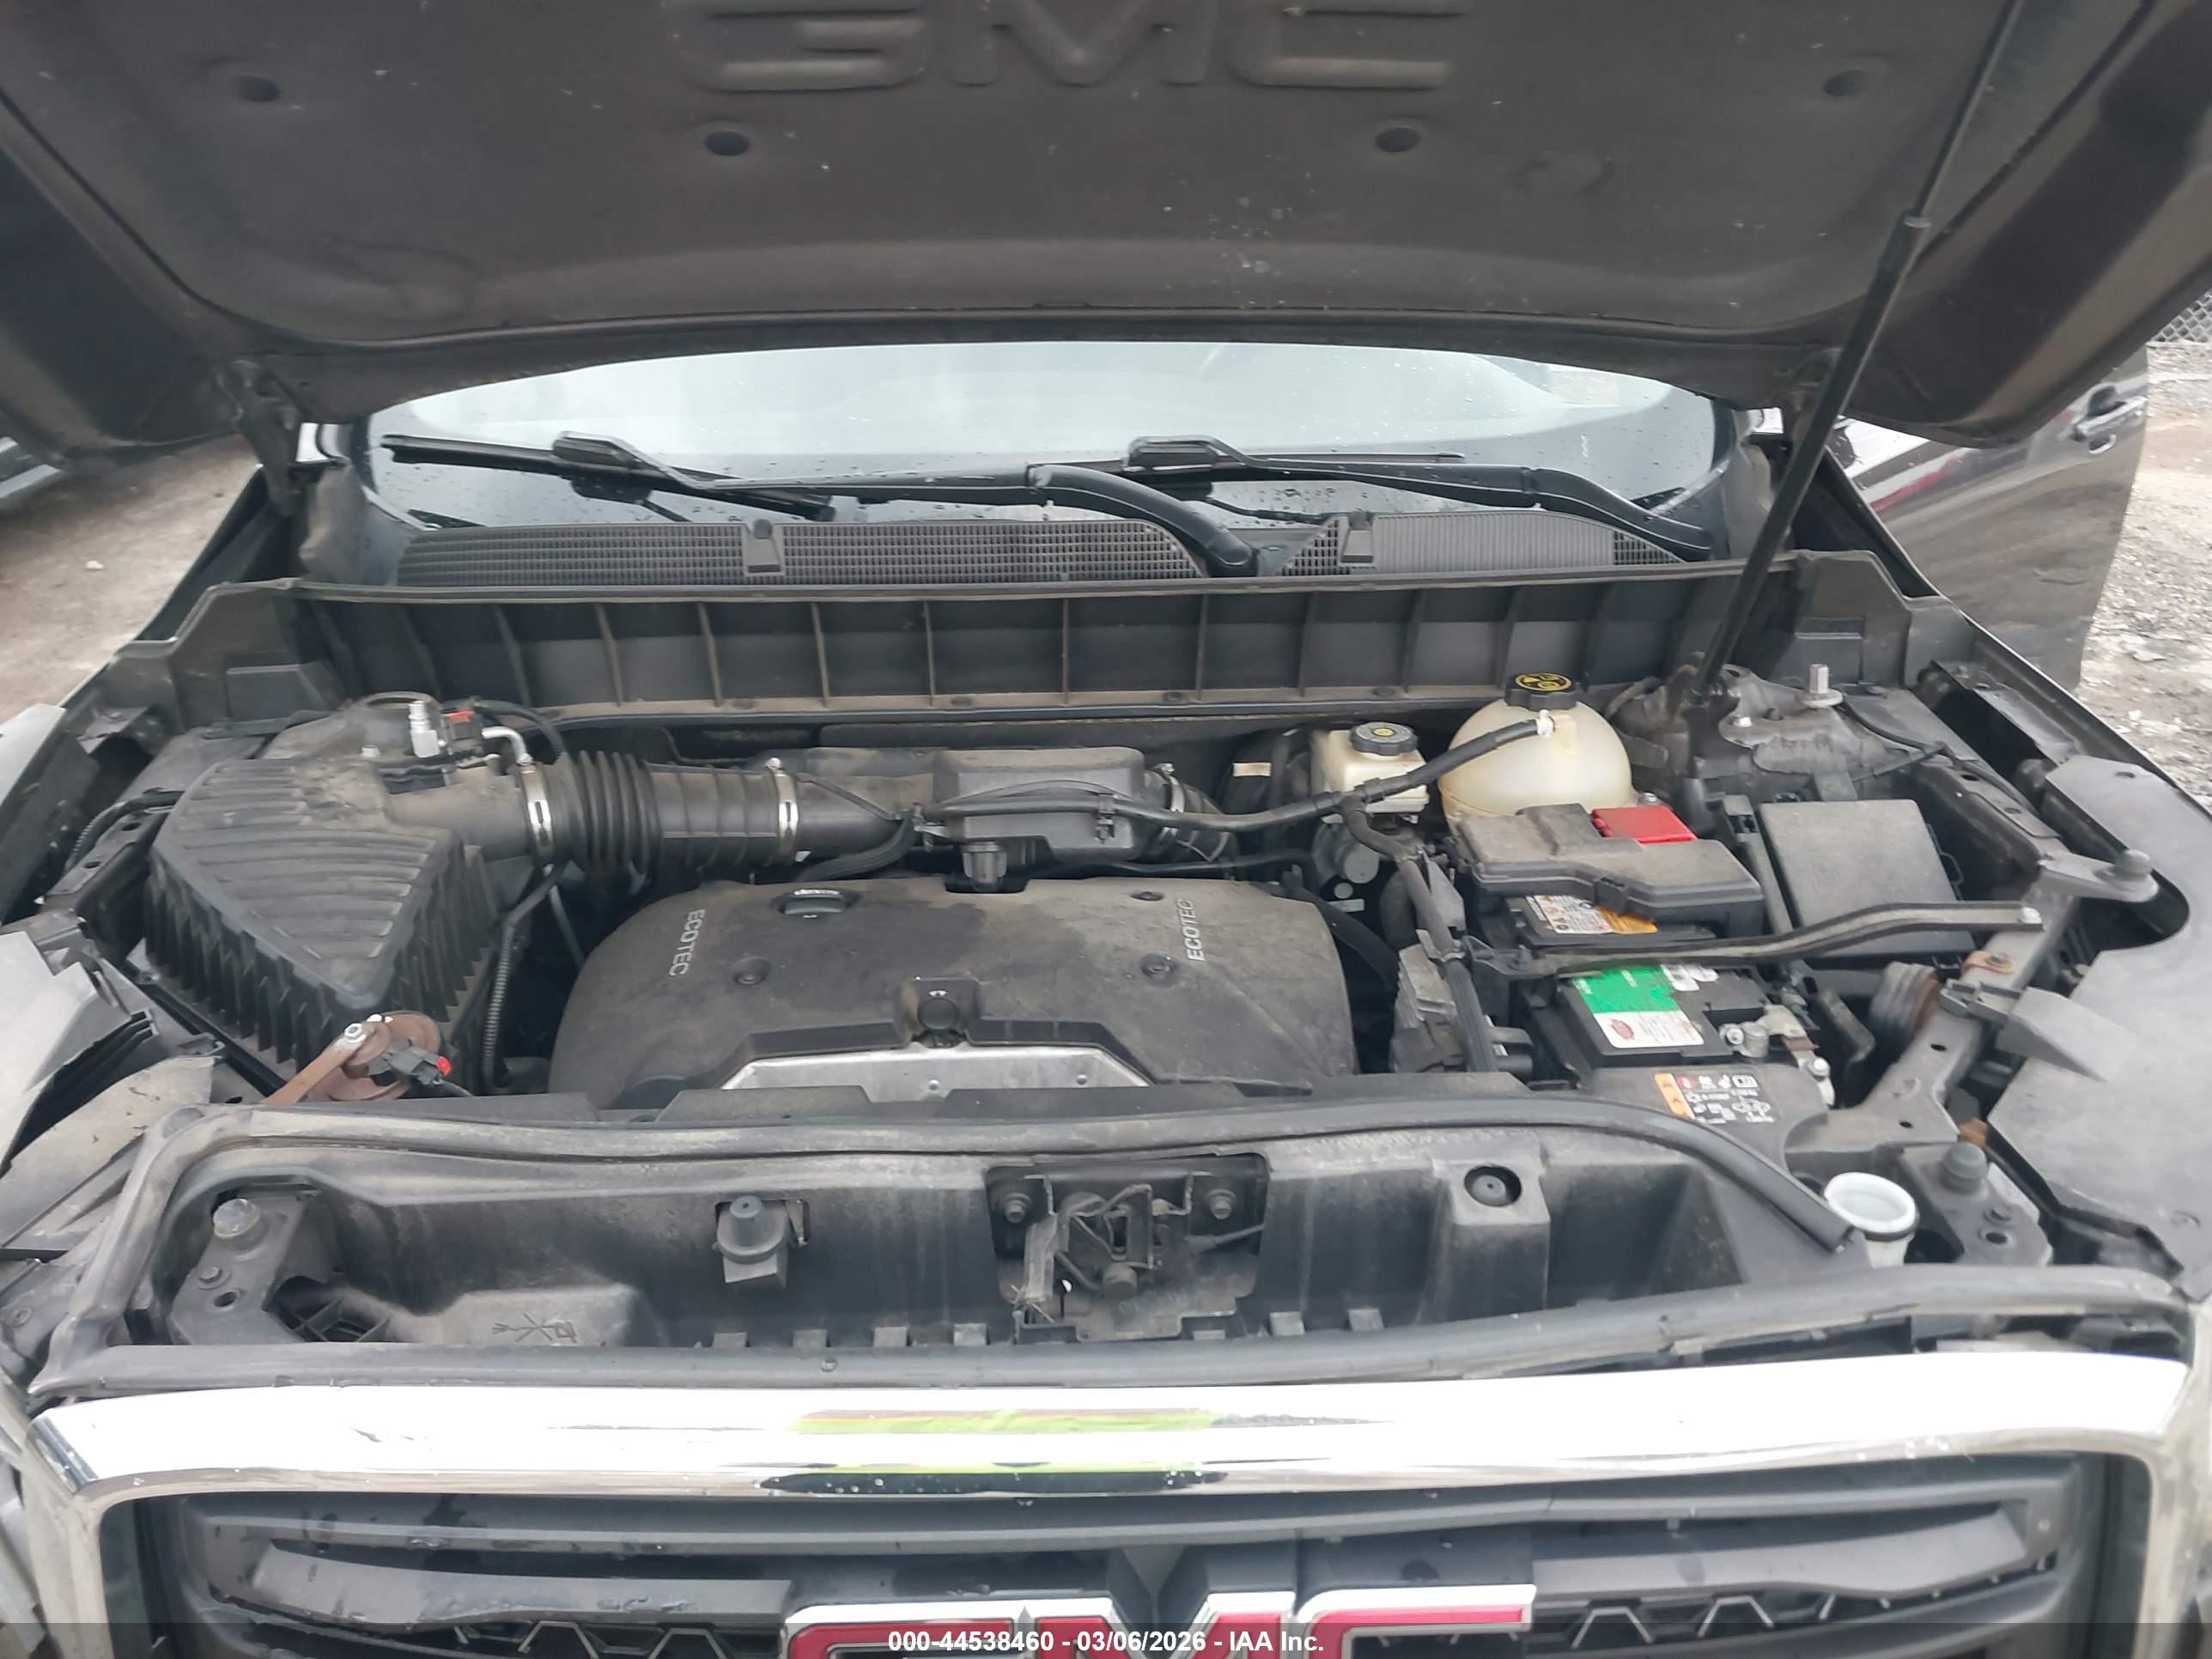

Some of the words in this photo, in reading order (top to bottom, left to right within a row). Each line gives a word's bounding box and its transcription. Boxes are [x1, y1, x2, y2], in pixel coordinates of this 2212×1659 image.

[663, 0, 1479, 93] GMC
[668, 908, 706, 976] ECOTEC
[1176, 899, 1206, 961] ECOTEC
